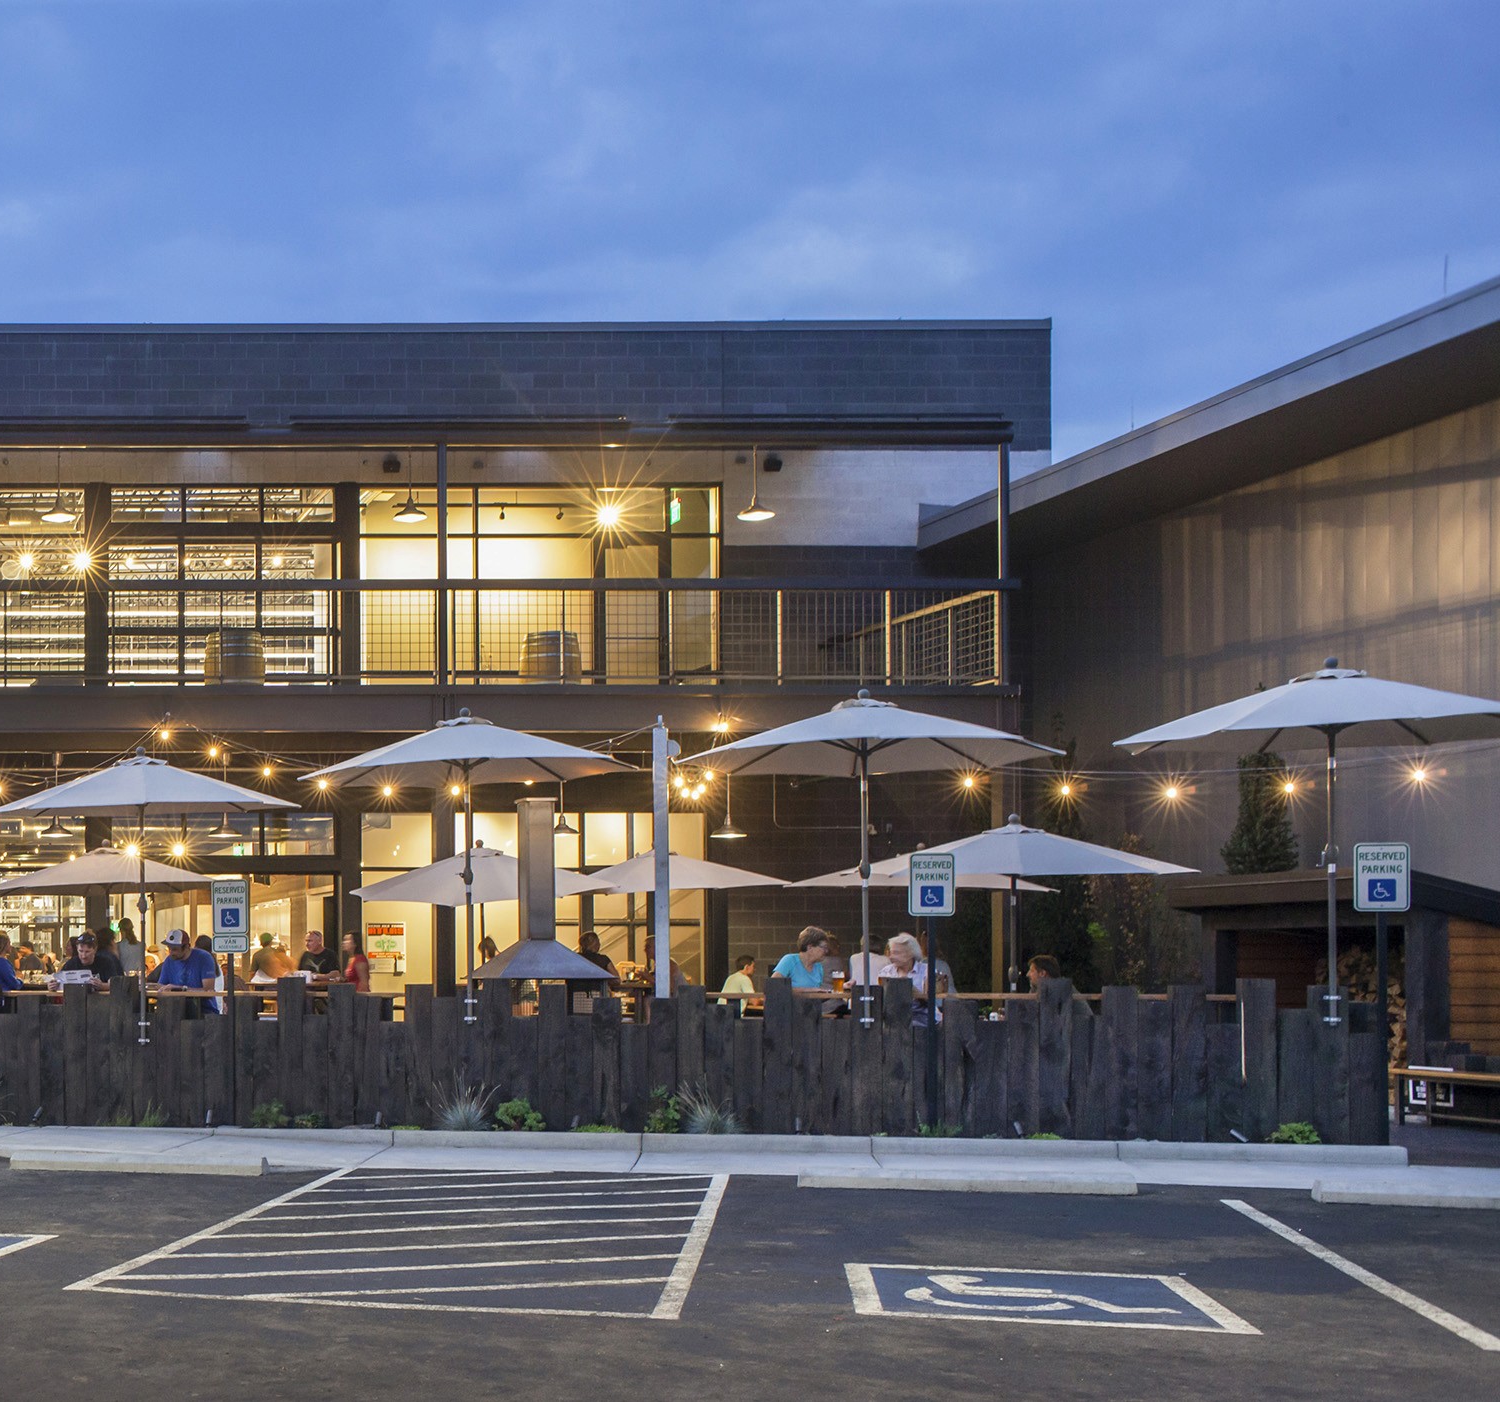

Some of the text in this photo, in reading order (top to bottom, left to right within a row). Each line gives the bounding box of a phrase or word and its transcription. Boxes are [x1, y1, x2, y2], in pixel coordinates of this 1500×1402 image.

[1358, 851, 1406, 861] RESERVED
[912, 860, 952, 870] RESERVED
[1361, 864, 1403, 874] PARKING
[915, 872, 950, 881] PARKING
[214, 886, 245, 895] RESERVED
[216, 897, 244, 905] PARKING
